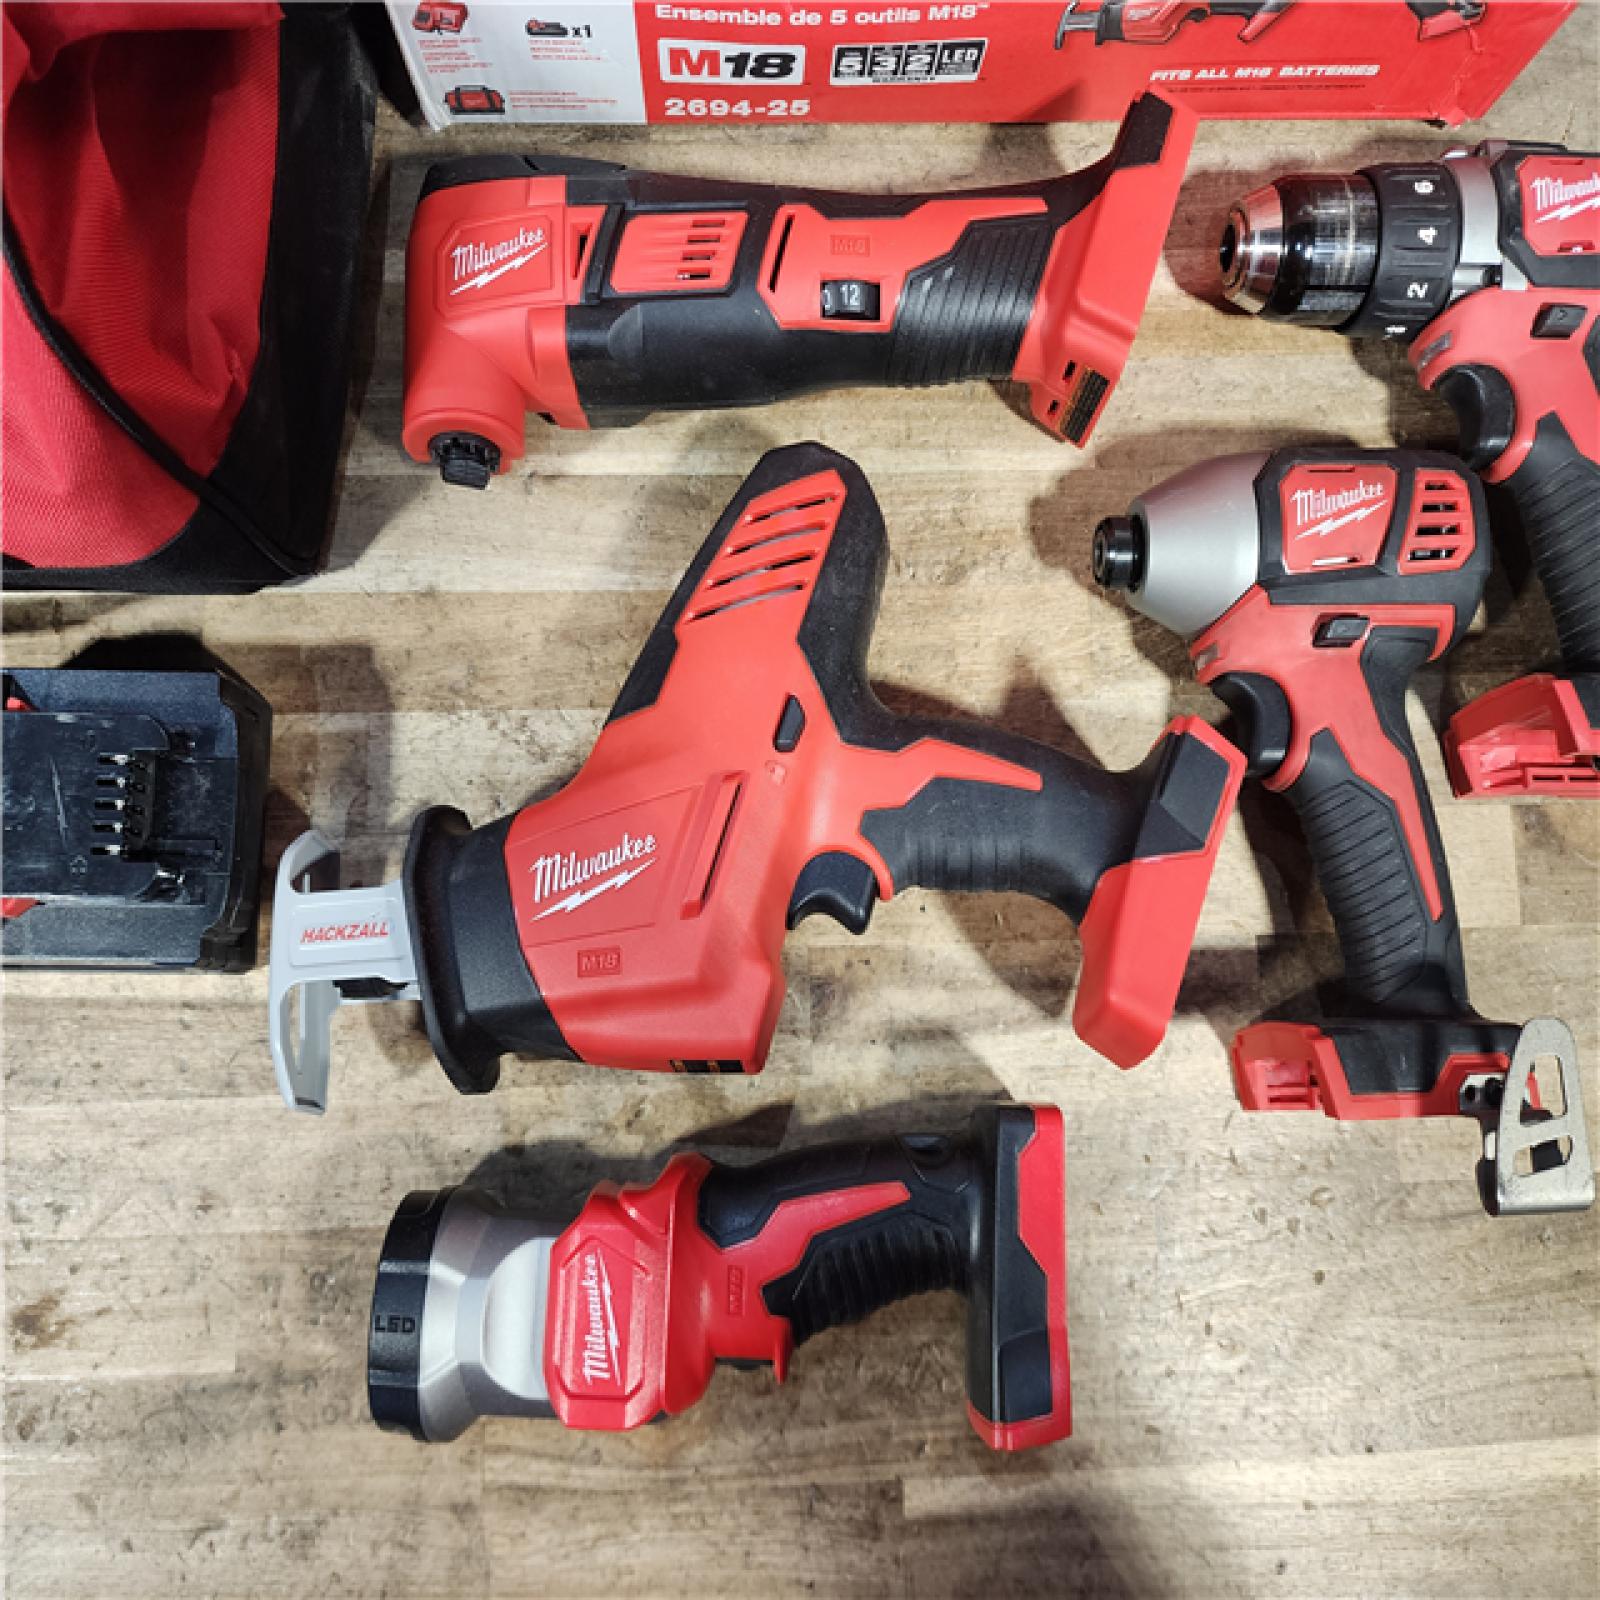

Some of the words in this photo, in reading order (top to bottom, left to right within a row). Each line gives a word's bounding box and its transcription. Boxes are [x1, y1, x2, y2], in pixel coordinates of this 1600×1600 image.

[655, 3, 782, 26] Ensemble
[789, 9, 821, 26] de
[829, 9, 848, 25] 5
[854, 6, 921, 25] outils
[668, 47, 798, 79] M18
[1150, 69, 1192, 81] FITS
[1195, 67, 1229, 79] ALL
[1279, 64, 1381, 77] BATTERIES
[664, 98, 811, 116] 2694-25
[1414, 181, 1434, 194] 6
[1417, 227, 1438, 245] 4
[450, 227, 543, 281] Milwaukee
[840, 284, 860, 306] 12
[1407, 282, 1429, 298] 2
[1290, 480, 1384, 527] Milwaukee
[529, 833, 656, 903] Milwaukee
[300, 921, 389, 944] HACKZALL
[374, 1315, 415, 1333] LED
[581, 1253, 611, 1385] Milwaukee
